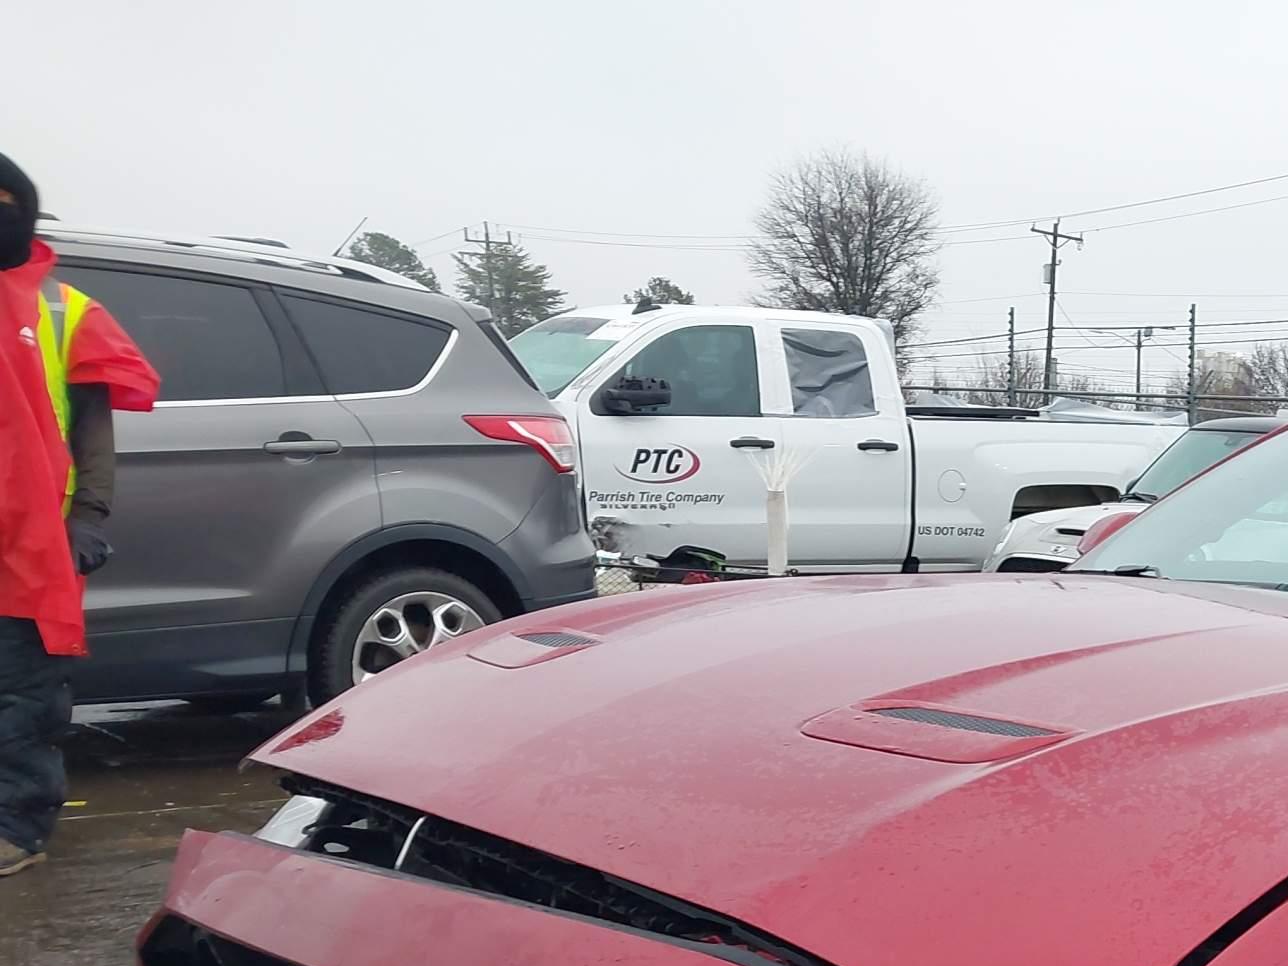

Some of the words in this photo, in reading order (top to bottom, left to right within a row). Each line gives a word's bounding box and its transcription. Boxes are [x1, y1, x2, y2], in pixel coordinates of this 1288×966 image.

[631, 448, 684, 474] PTC
[589, 491, 634, 502] Parrish
[639, 491, 662, 502] Tire
[665, 491, 725, 505] Company
[918, 526, 932, 535] US
[935, 526, 955, 536] DOT
